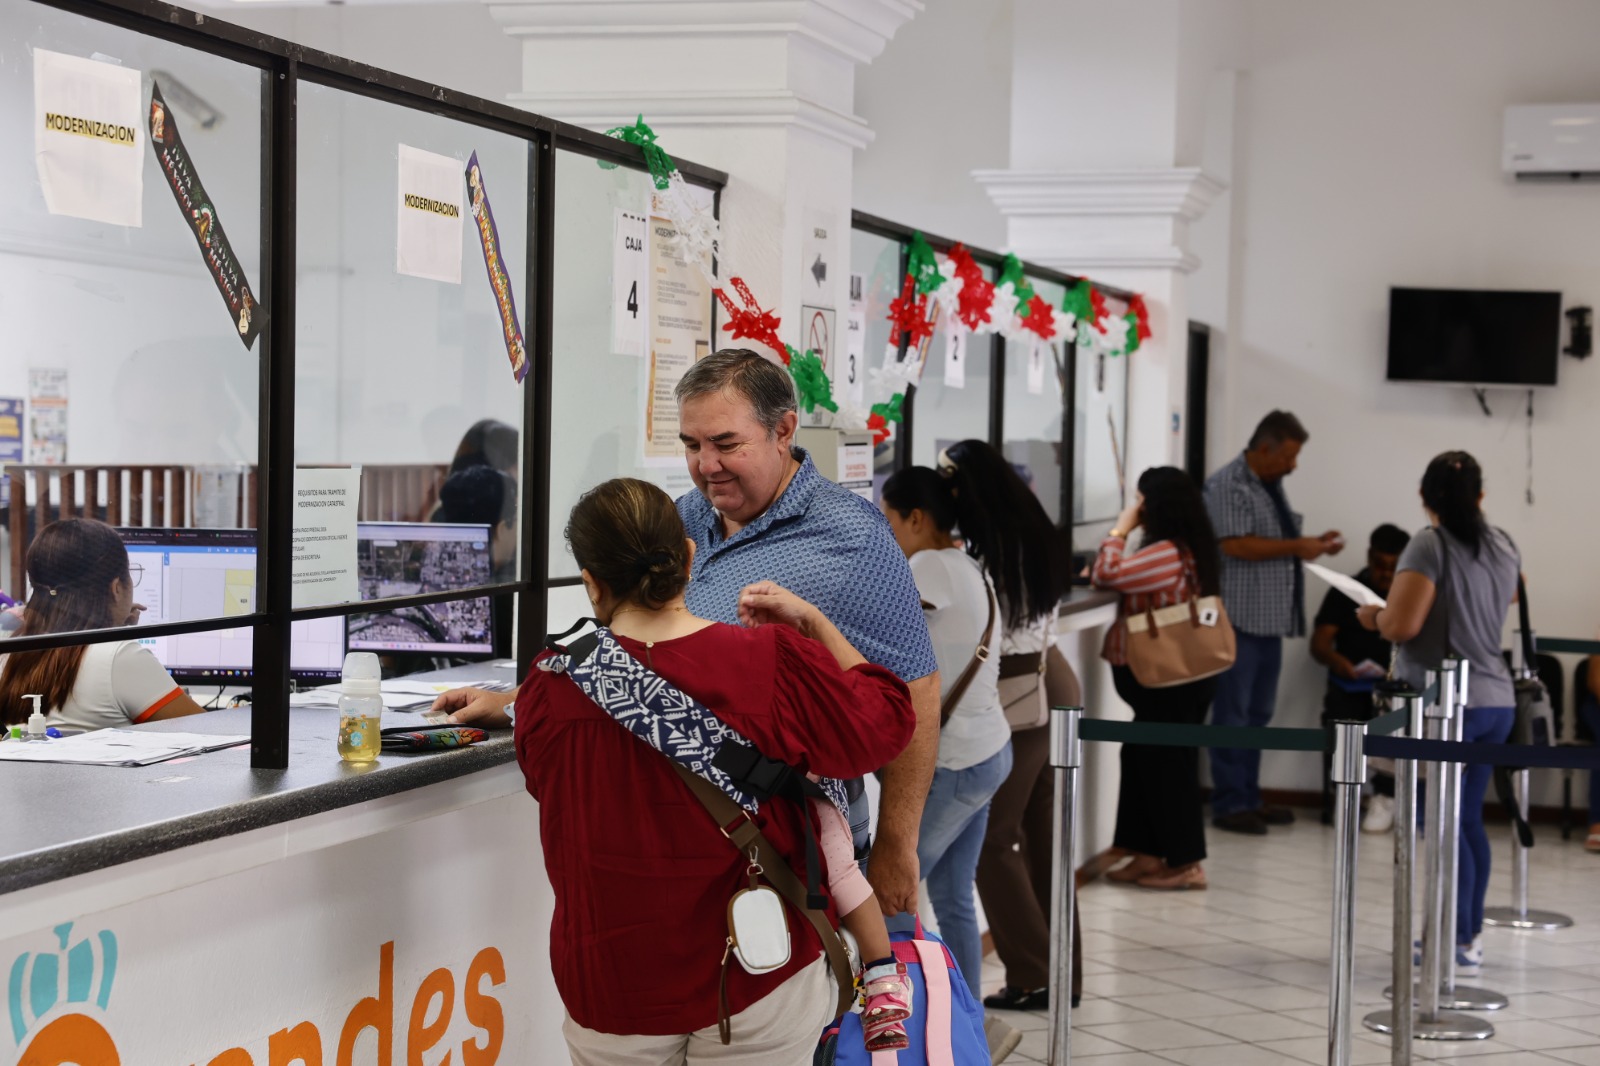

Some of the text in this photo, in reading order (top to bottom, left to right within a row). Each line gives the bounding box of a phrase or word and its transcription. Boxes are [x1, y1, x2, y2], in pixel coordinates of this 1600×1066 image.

[45, 112, 136, 143] MODERNIZACION
[404, 193, 459, 218] MODERNIZACION
[625, 236, 642, 252] CAJA
[627, 280, 638, 319] 4
[849, 354, 856, 384] 3
